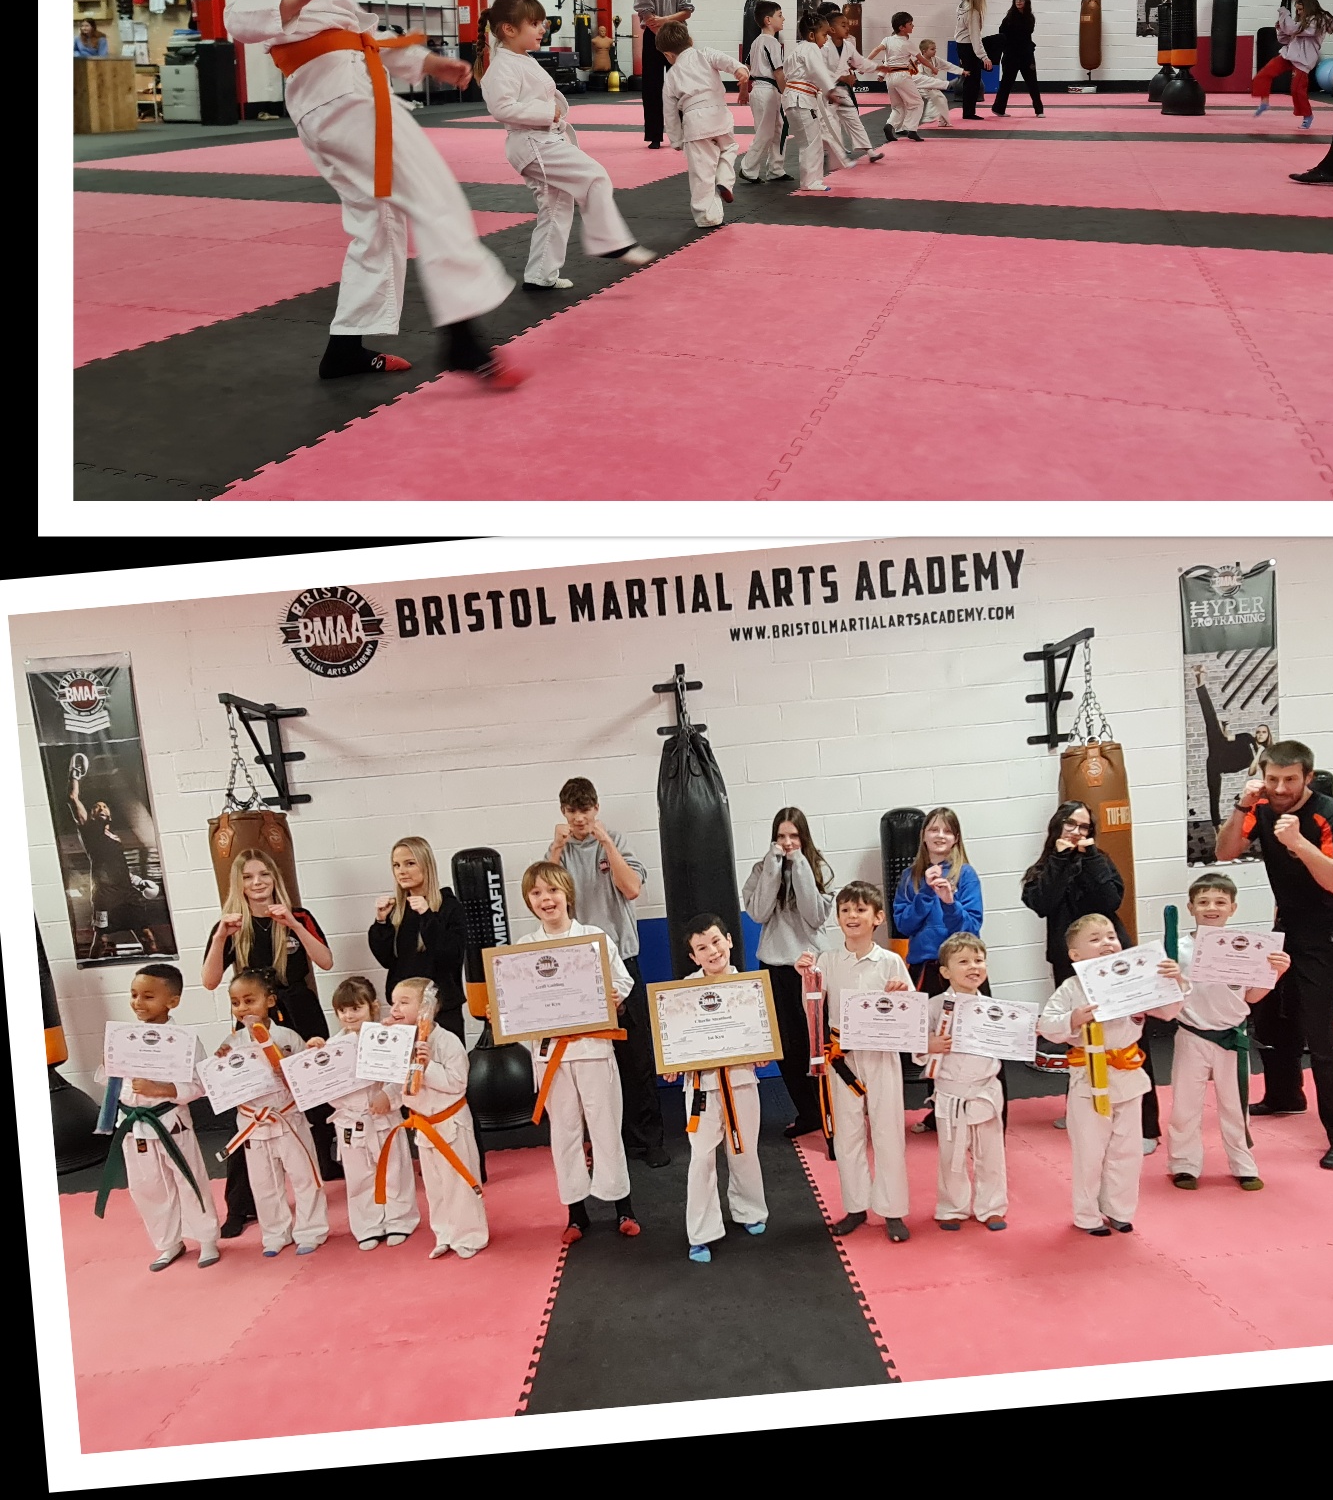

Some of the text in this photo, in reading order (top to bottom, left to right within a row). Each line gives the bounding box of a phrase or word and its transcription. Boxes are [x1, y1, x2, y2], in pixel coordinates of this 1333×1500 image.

[291, 587, 366, 616] BRISTOL
[394, 549, 1025, 640] BRISTOL MARTIAL ARTS ACADEMY
[1190, 596, 1266, 618] HYPER
[298, 613, 366, 648] BMAA
[729, 605, 1016, 642] WWW.BRISTOLMARTIALARTSACADEMY.COM
[296, 643, 375, 676] MARTIAL ARTS ACADEMY
[60, 671, 99, 687] BRISTOL
[65, 685, 100, 702] BMAA
[487, 870, 508, 947] MIRAFIT
